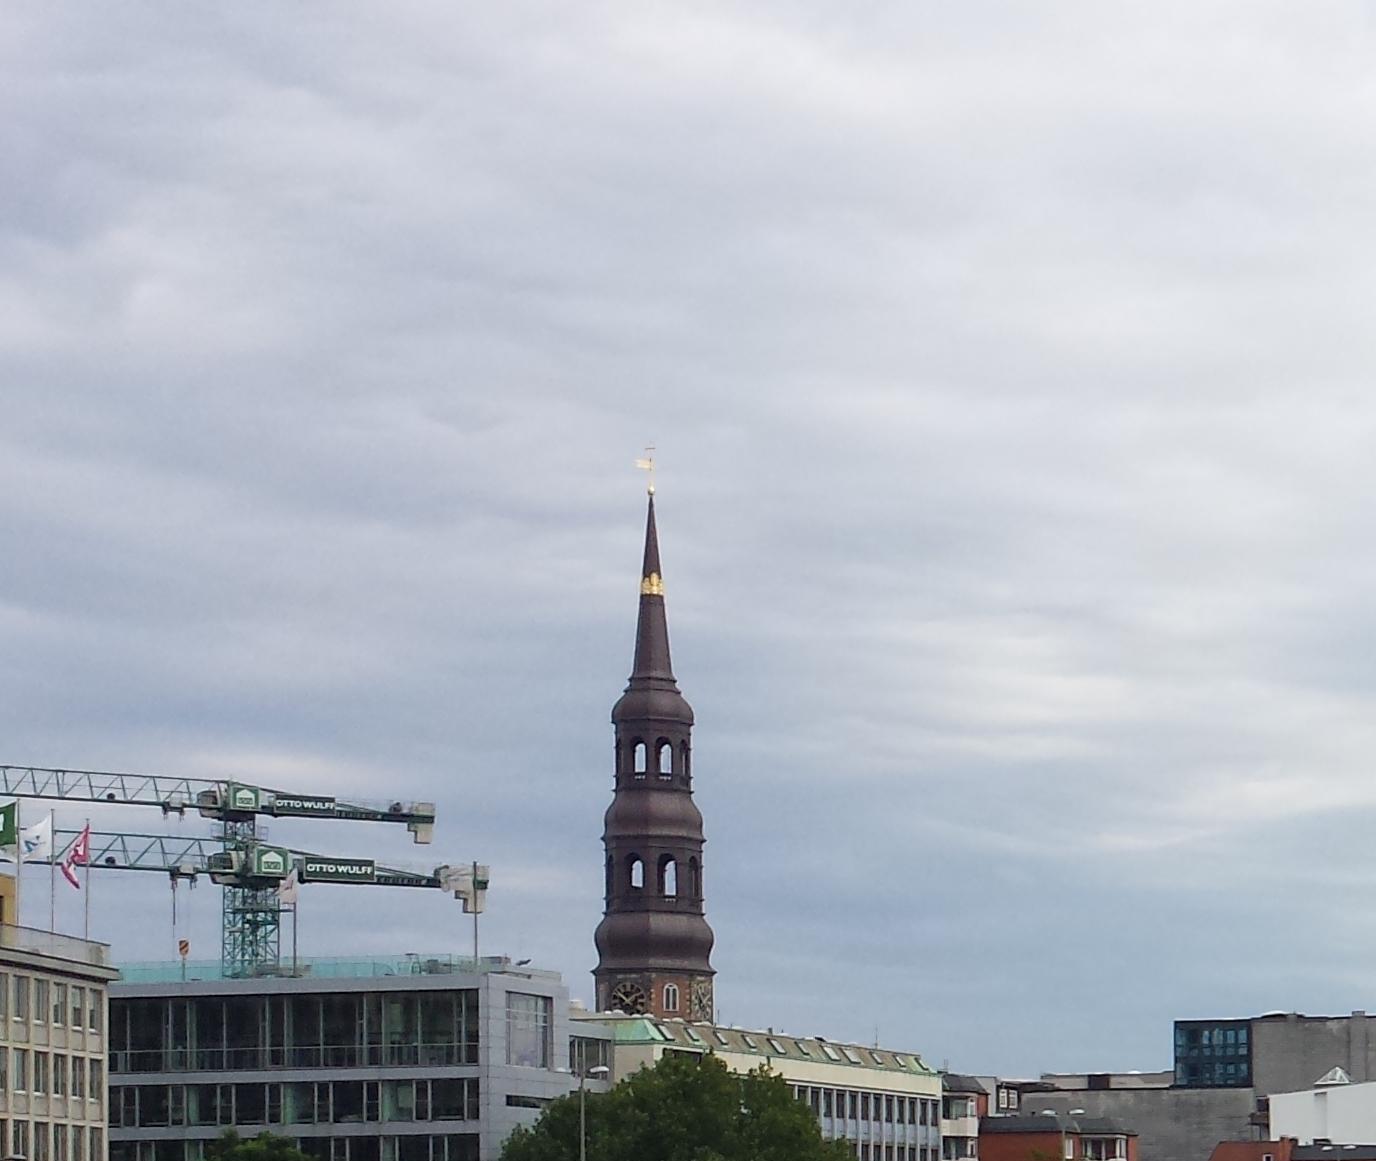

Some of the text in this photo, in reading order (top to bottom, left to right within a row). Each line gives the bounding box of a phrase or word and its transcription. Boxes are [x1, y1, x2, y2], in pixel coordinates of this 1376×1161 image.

[276, 800, 335, 809] OTTO WULFF
[306, 863, 373, 874] OTTO WULFF
